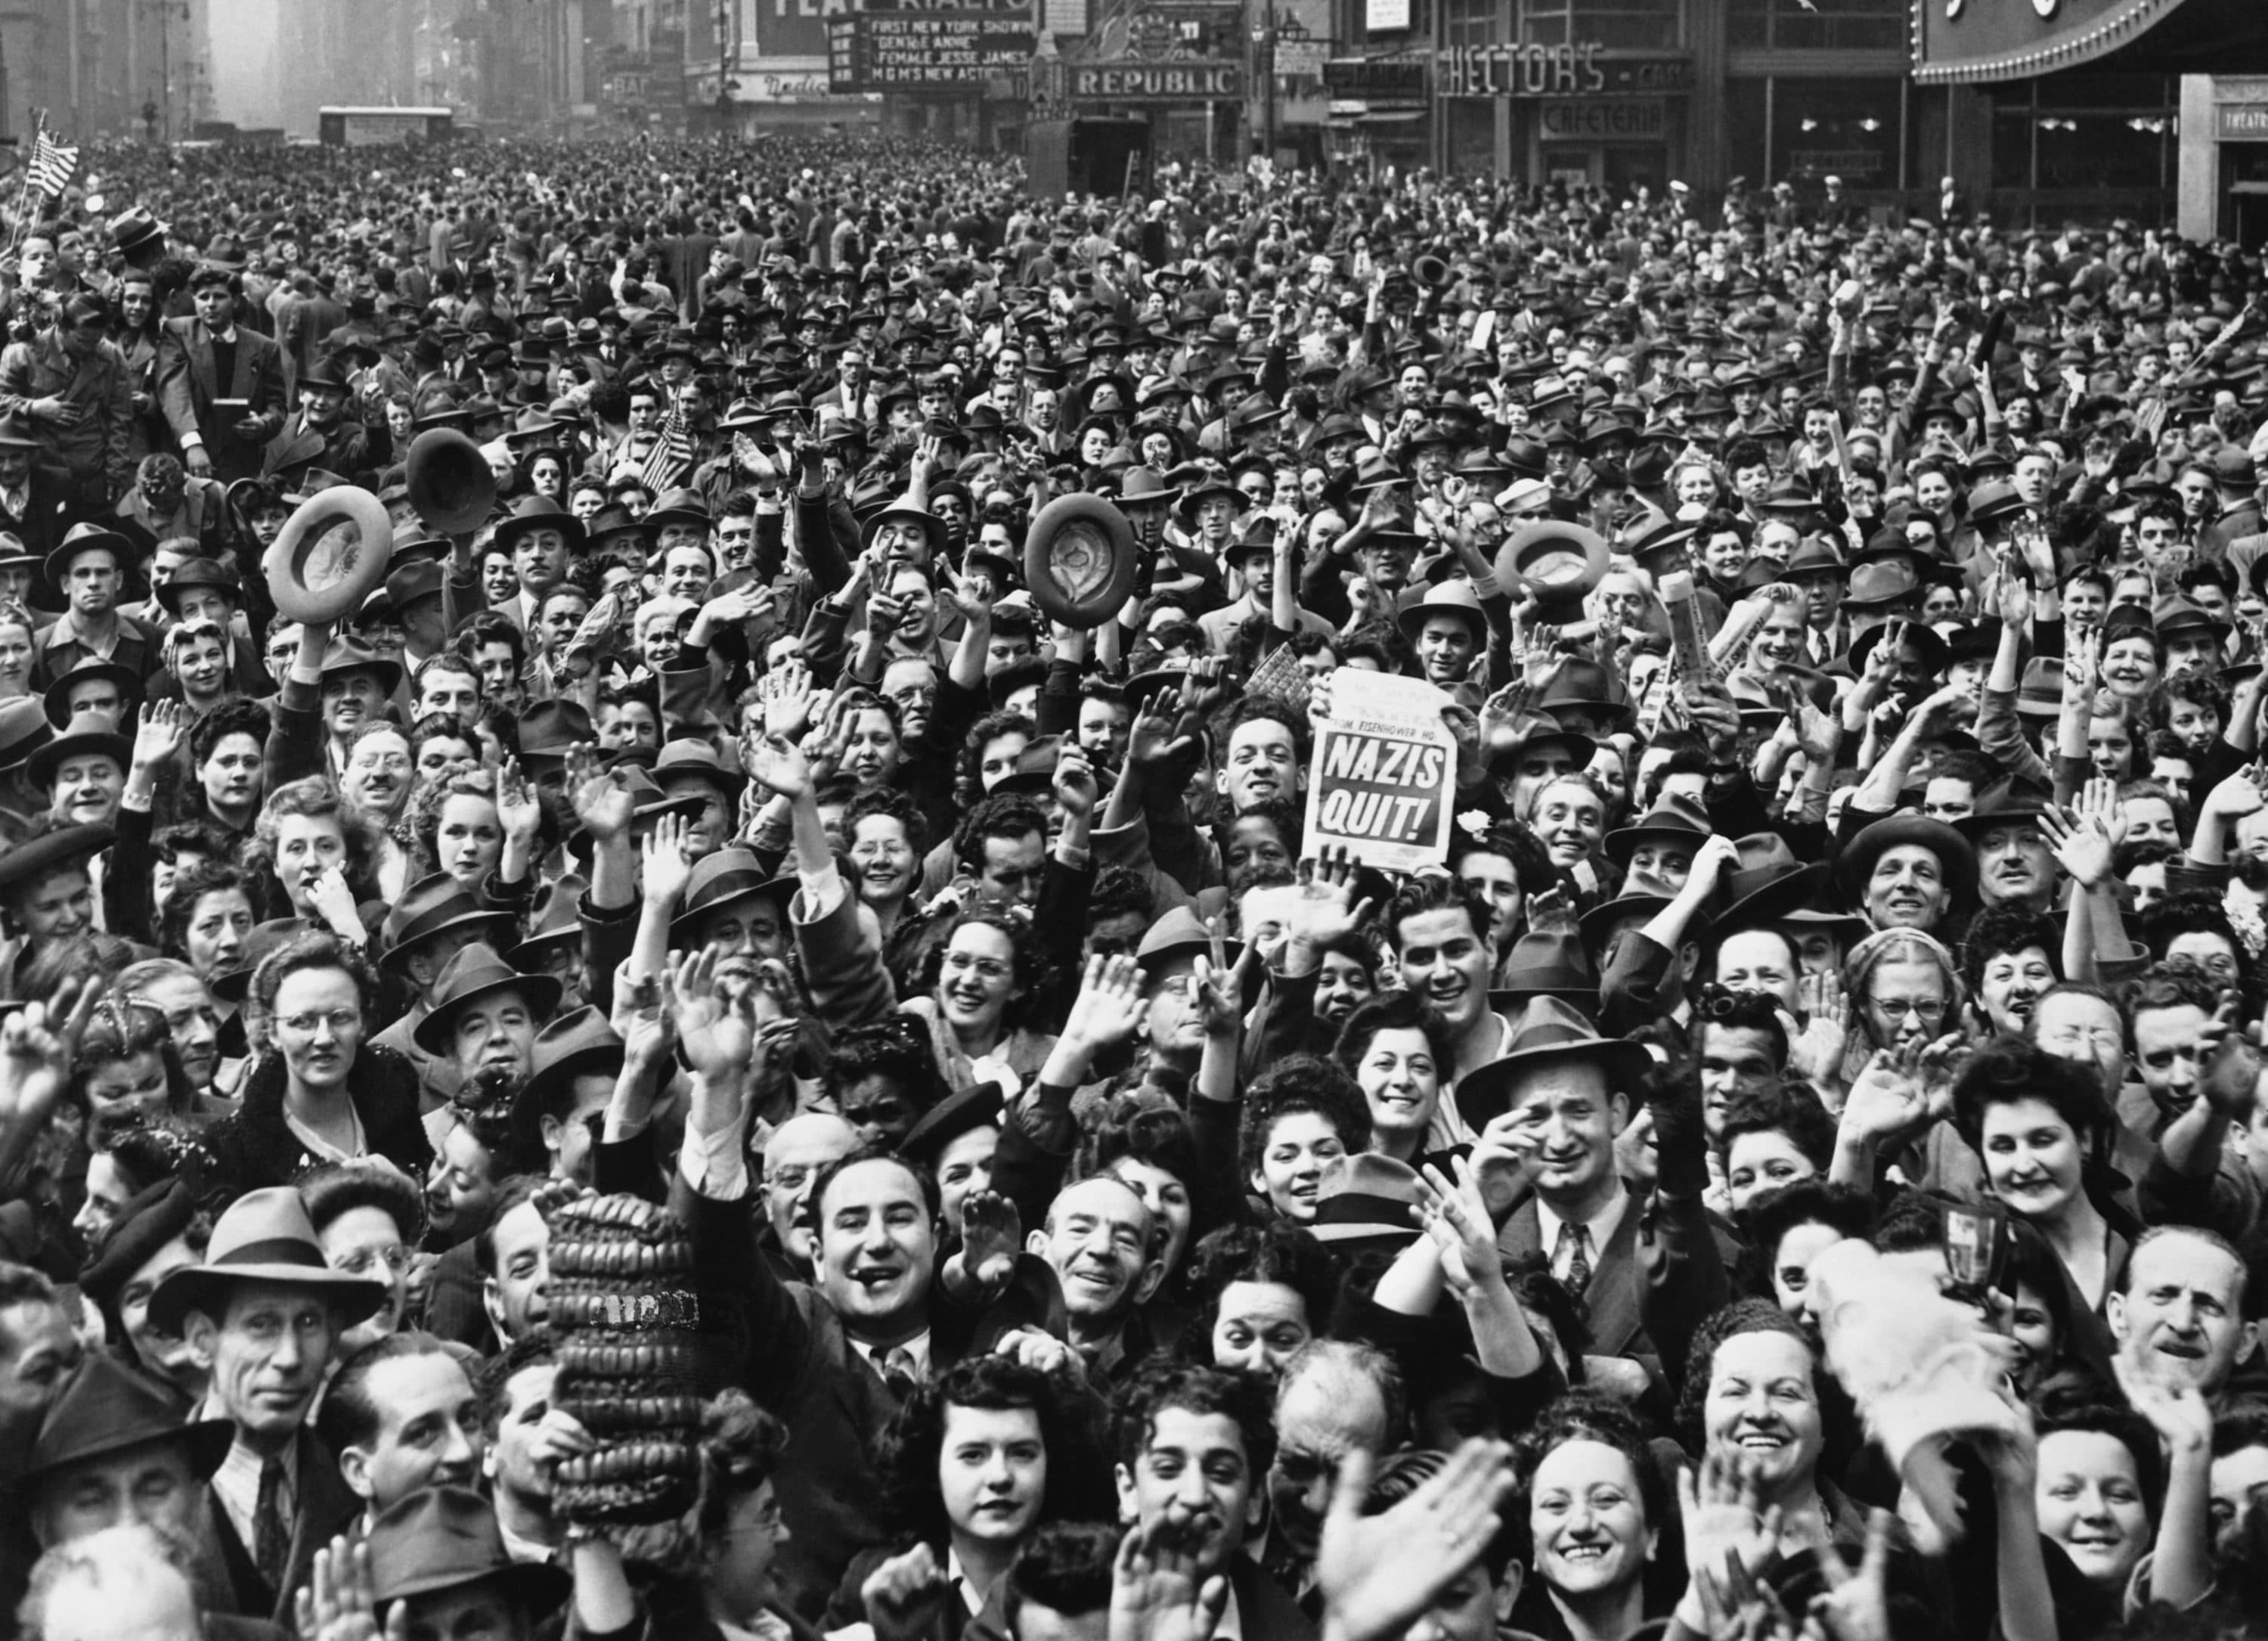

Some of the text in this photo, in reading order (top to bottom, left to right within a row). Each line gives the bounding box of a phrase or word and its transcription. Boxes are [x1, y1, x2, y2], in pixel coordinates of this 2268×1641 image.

[872, 20, 1033, 33] FIRST NEW YORK SHOWIN
[878, 51, 1027, 65] FEMALE JESSE JAMES
[925, 67, 953, 81] NEW
[1450, 44, 1604, 94] HECTOR'S
[1079, 70, 1233, 94] REPUBLIC
[1544, 104, 1662, 132] CAFETERIA
[2226, 113, 2268, 129] THEATR
[1359, 721, 1417, 737] EISENHOWER
[1325, 735, 1444, 789] NAZIS
[1321, 789, 1431, 841] QUIT!
